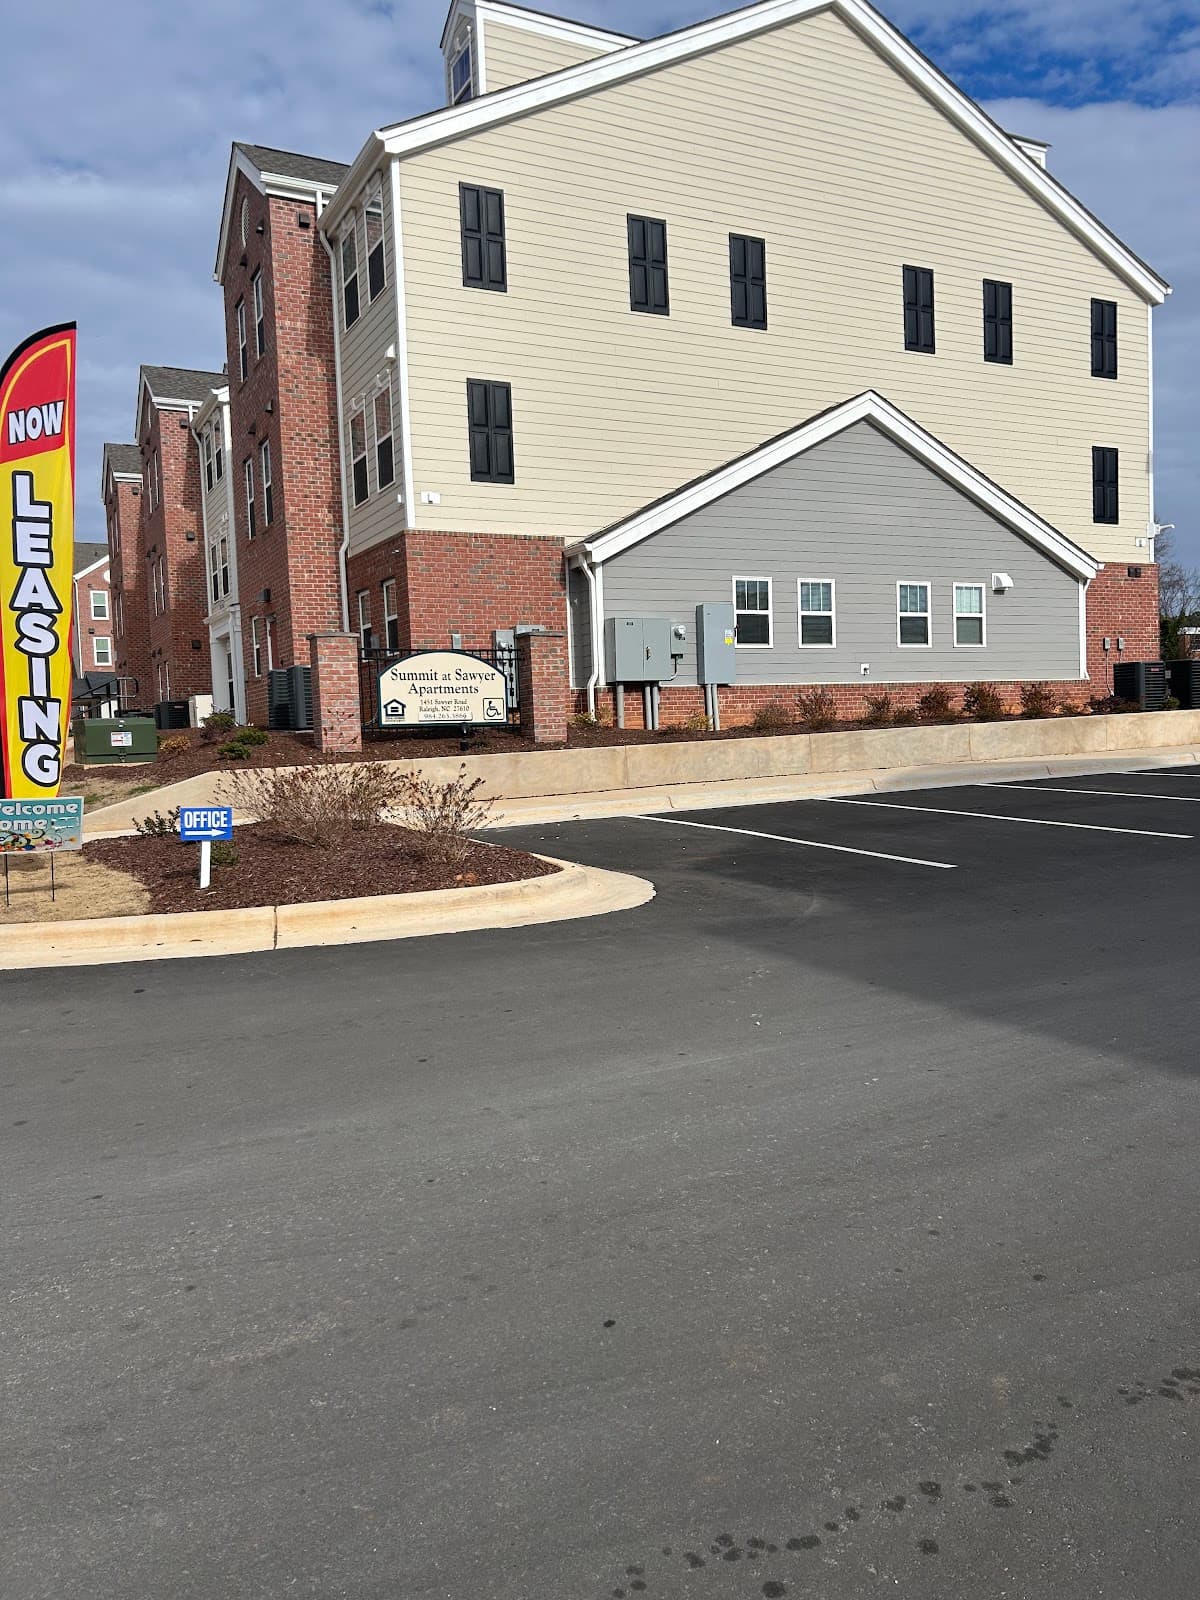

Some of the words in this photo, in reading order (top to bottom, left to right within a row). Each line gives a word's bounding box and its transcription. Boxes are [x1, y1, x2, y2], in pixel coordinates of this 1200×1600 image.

[8, 400, 65, 445] NOW
[9, 470, 63, 787] LEASING
[390, 668, 438, 681] Summit
[442, 673, 451, 681] at
[455, 668, 496, 684] Sawyer
[408, 683, 479, 697] Apartments
[0, 802, 78, 816] elcome
[0, 819, 48, 831] ome
[184, 810, 228, 829] OFFICE
